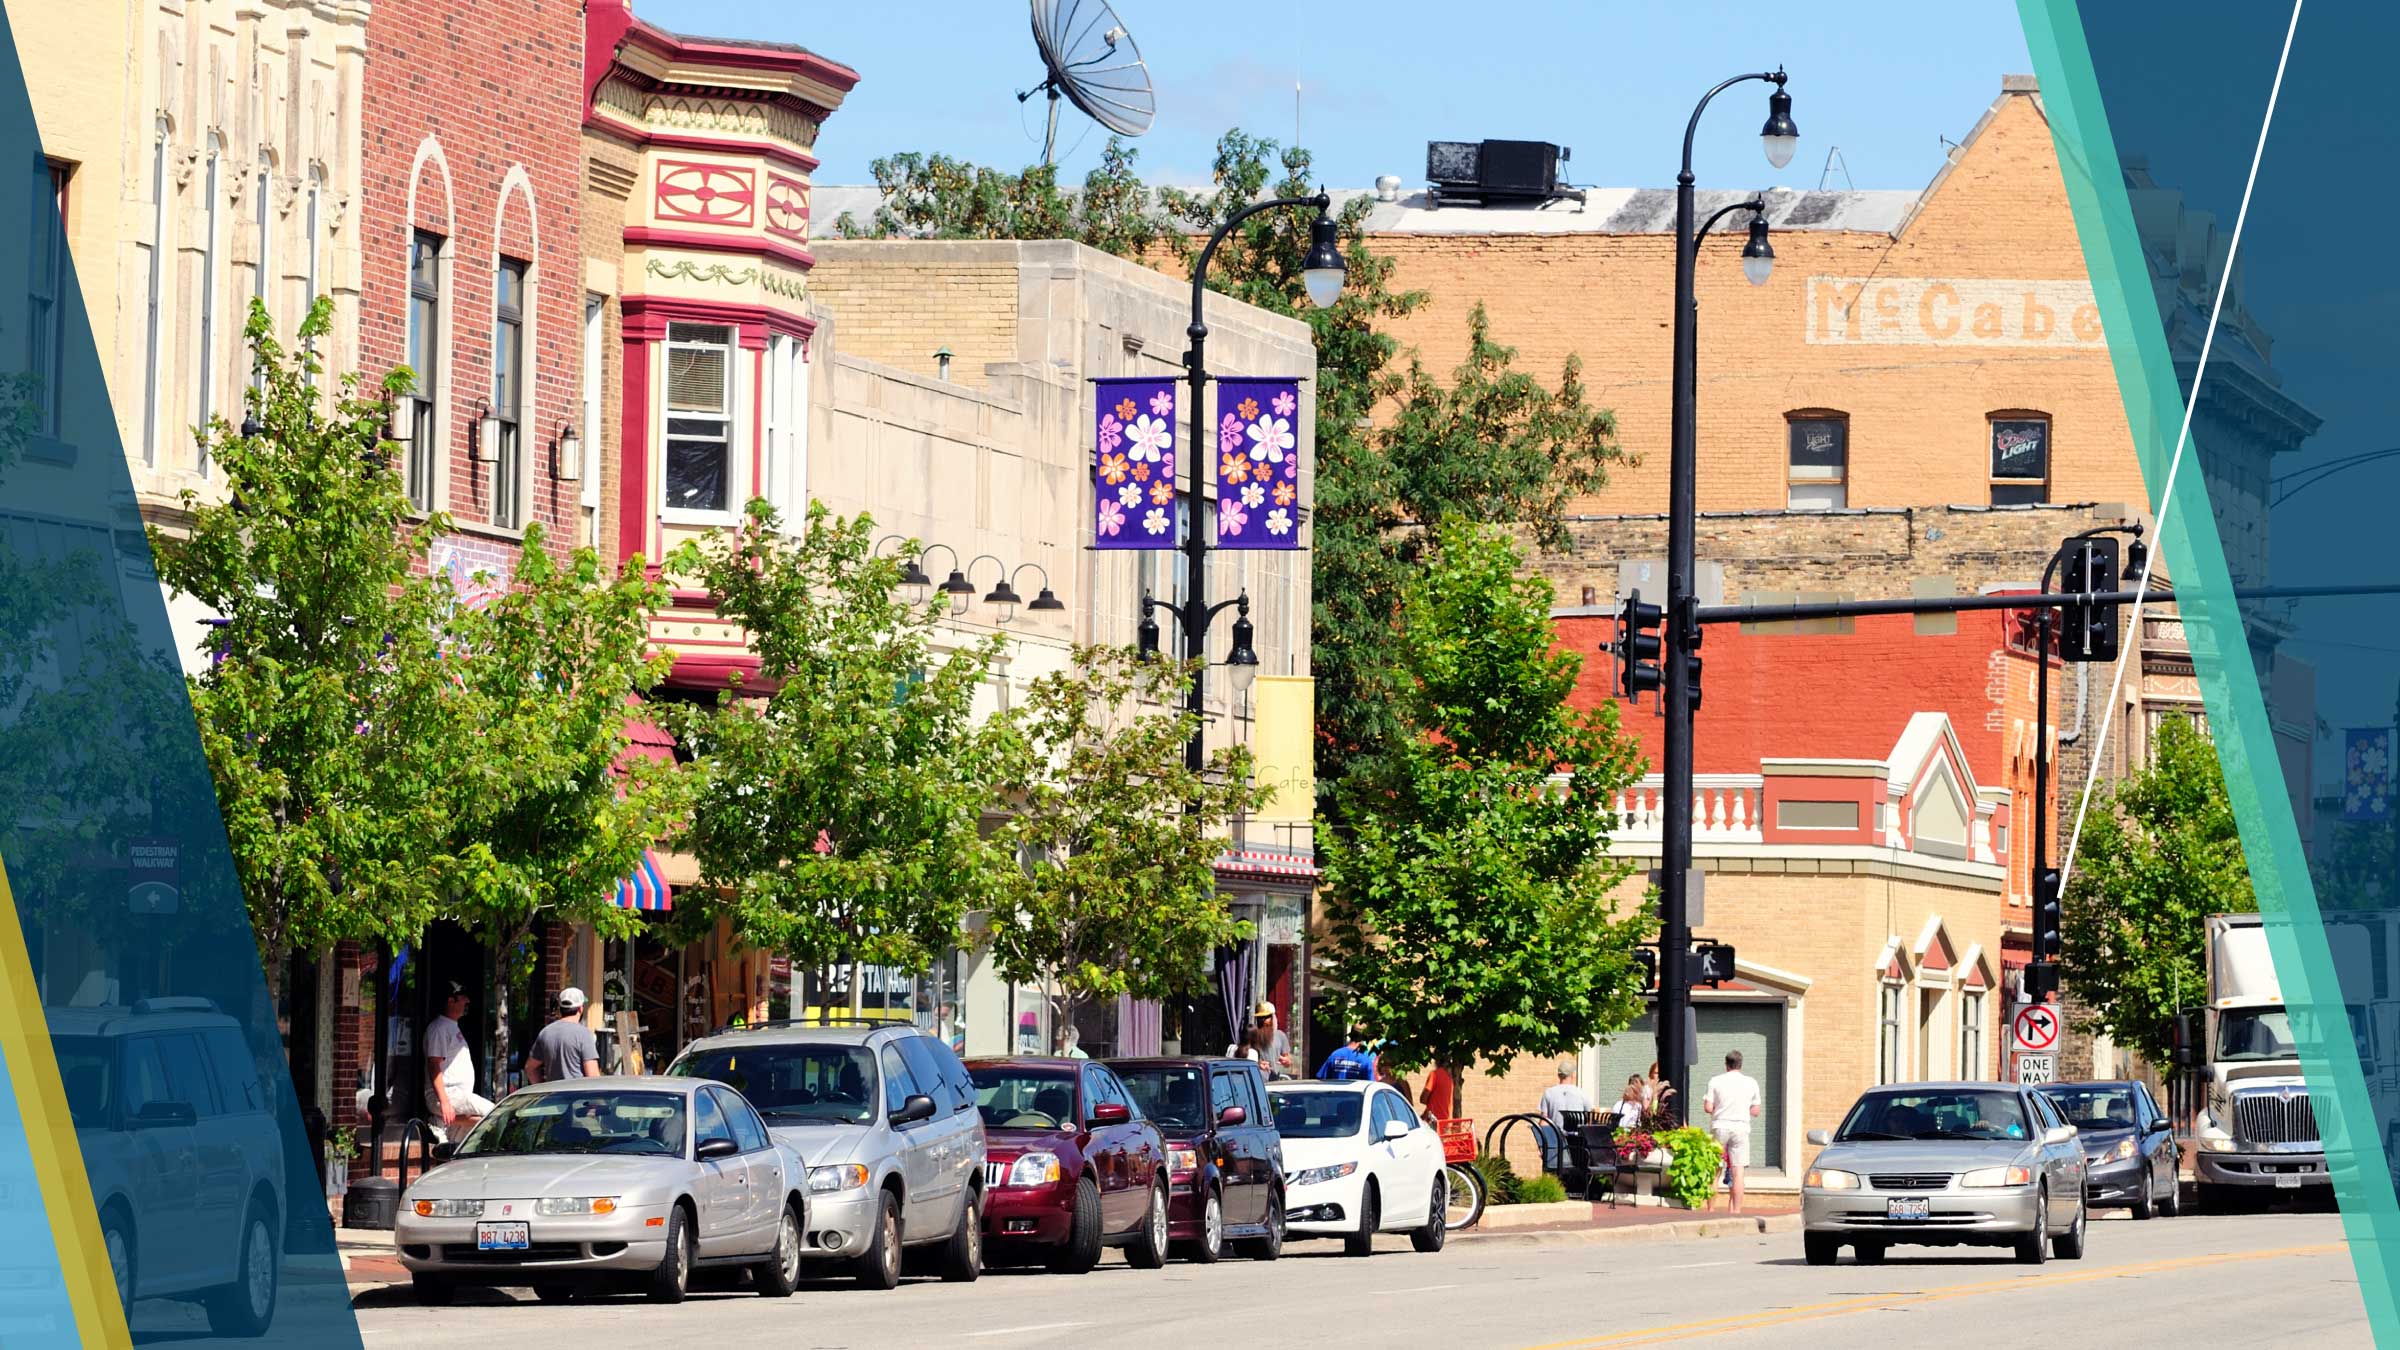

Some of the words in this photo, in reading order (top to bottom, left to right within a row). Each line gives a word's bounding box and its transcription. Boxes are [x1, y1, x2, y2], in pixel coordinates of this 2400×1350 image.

[1814, 282, 2104, 342] McCabe
[2001, 440, 2039, 460] LIGHT
[1258, 765, 1309, 794] Cafe
[131, 846, 178, 857] PEDESTRIAN
[132, 857, 176, 868] WALKWAY
[2022, 1058, 2049, 1070] ONE
[2022, 1071, 2050, 1084] WAY
